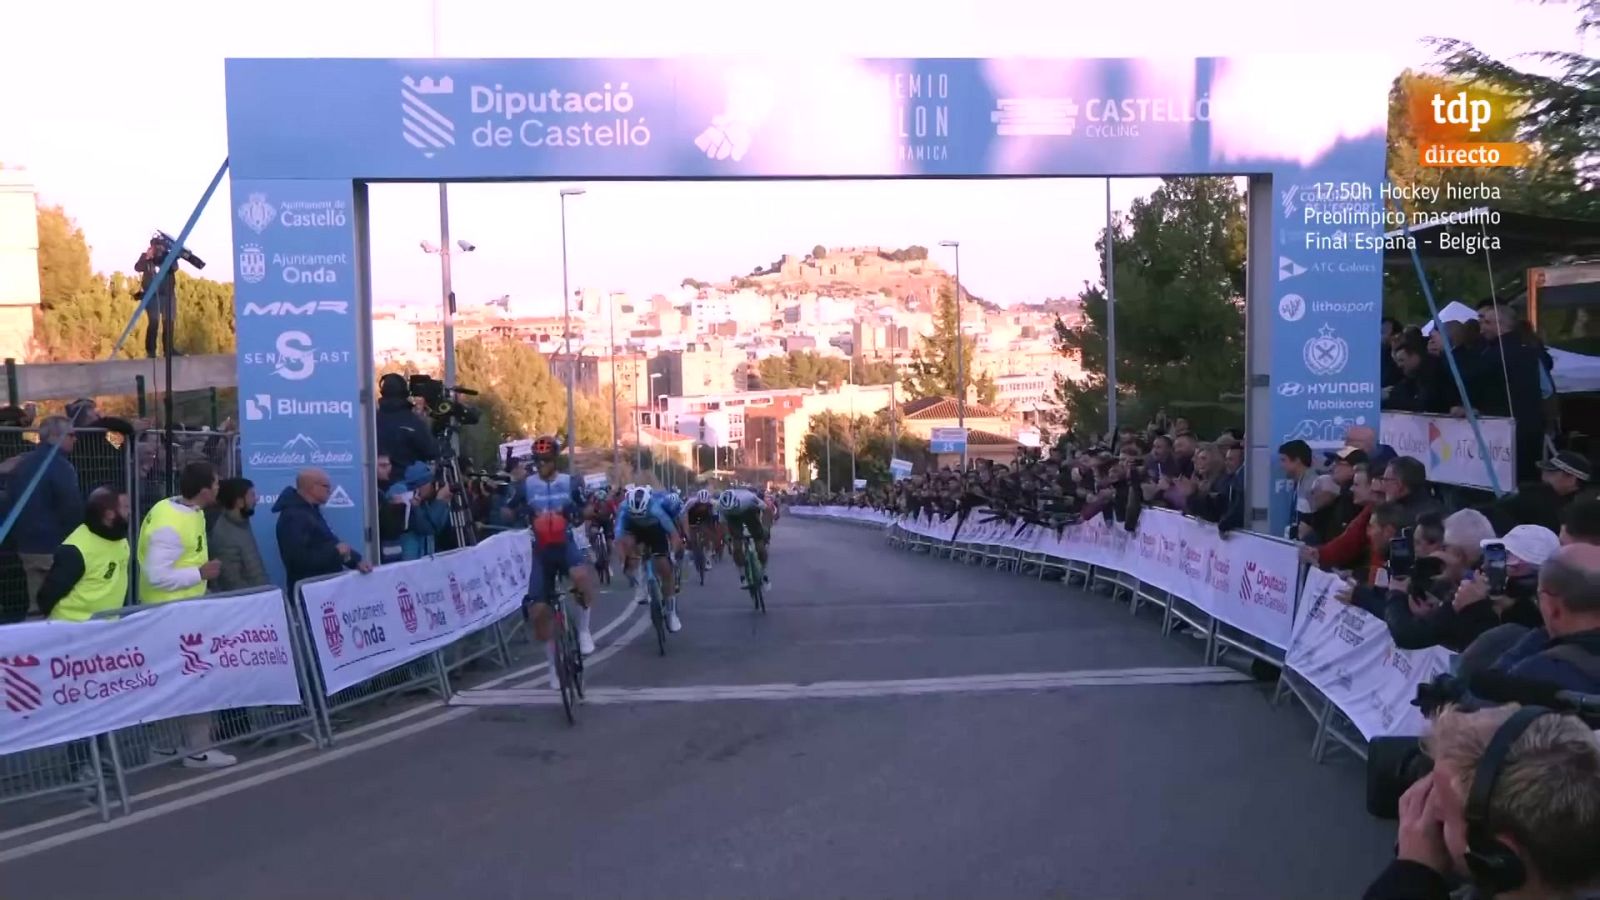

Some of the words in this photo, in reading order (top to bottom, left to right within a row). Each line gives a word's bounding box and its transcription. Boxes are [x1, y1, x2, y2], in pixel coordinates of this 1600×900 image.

[470, 82, 635, 119] Diputació
[472, 120, 512, 148] de
[519, 118, 651, 149] Castelló
[1085, 125, 1140, 138] CYCLING
[280, 209, 346, 227] Castelló
[272, 253, 347, 267] Ajuntament
[1310, 262, 1334, 272] ATC
[282, 266, 337, 283] Onda
[242, 301, 349, 316] MMR
[1311, 301, 1374, 313] lithosport
[1307, 382, 1374, 393] HYUNDAI
[277, 398, 353, 418] Blumaq
[1307, 400, 1374, 410] Mobikorea
[351, 623, 386, 650] Onda
[50, 646, 146, 681] Diputació
[219, 651, 240, 668] de
[52, 684, 81, 706] de
